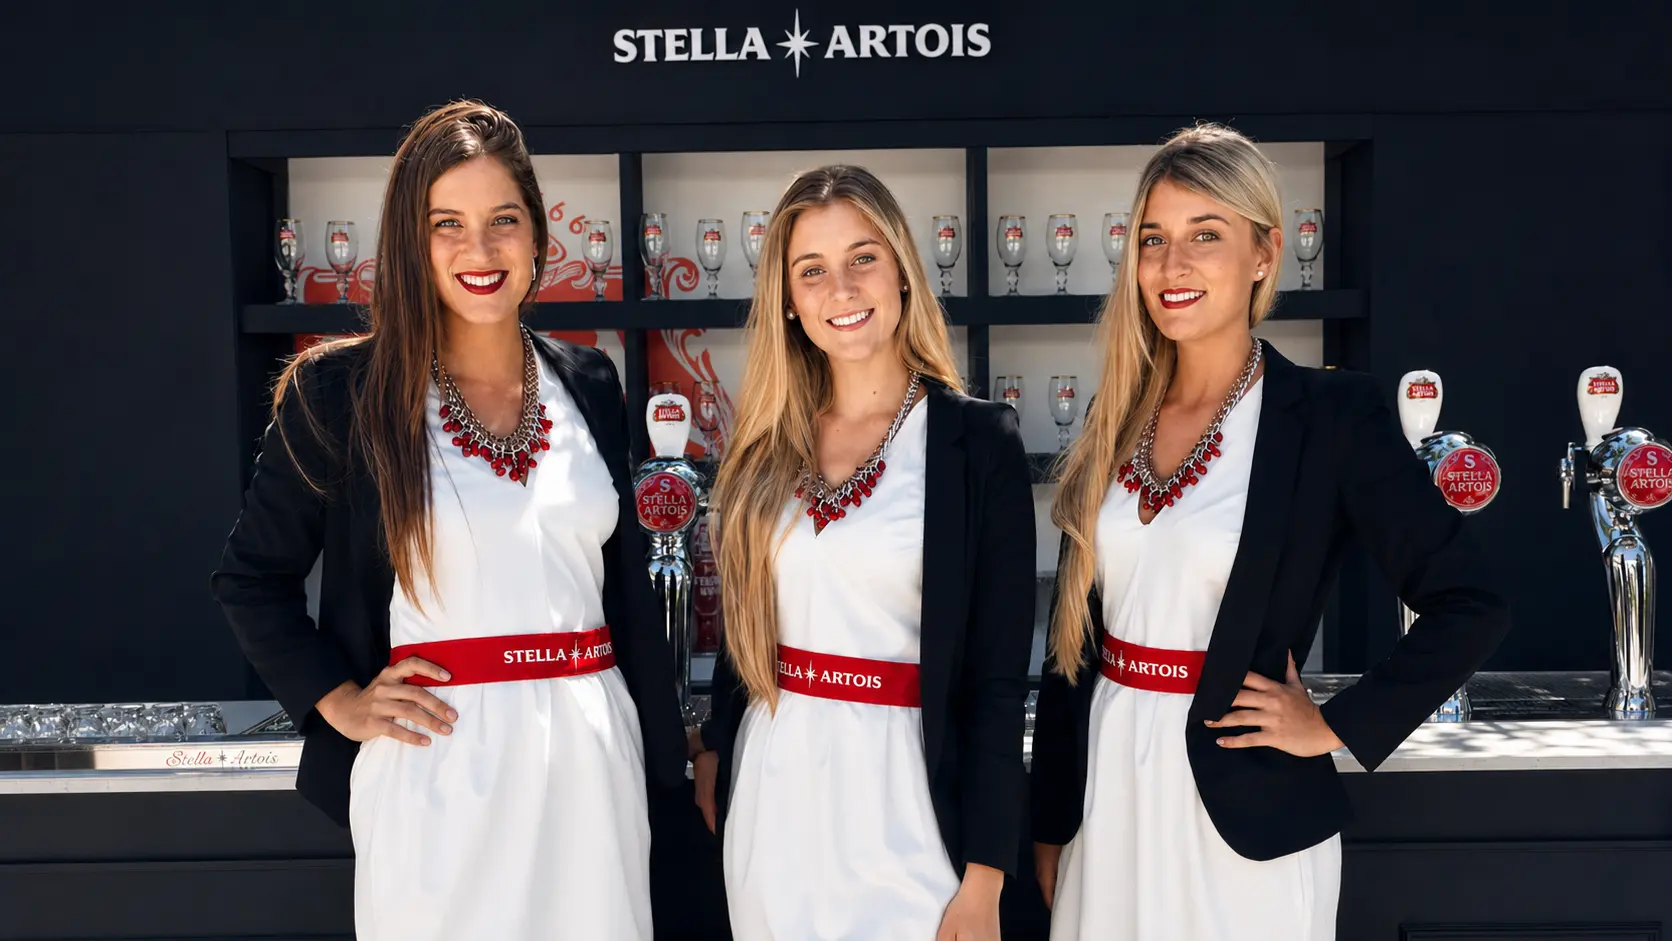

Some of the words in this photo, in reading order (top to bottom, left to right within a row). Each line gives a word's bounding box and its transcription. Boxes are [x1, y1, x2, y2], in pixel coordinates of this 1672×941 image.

[613, 27, 771, 63] STELLA
[824, 22, 992, 59] ARTOIS
[1464, 454, 1476, 469] S
[1646, 450, 1657, 466] S
[1447, 471, 1493, 482] STELLA
[659, 478, 671, 493] S
[1448, 481, 1492, 492] ARTOIS
[642, 495, 687, 505] STELLA
[643, 505, 688, 515] ARTOIS
[504, 648, 568, 664] STELLA
[584, 641, 613, 660] ARTOIS
[1128, 659, 1189, 679] ARTOIS
[820, 670, 882, 689] ARTOIS
[165, 750, 213, 767] Stella
[230, 749, 279, 765] Artois
